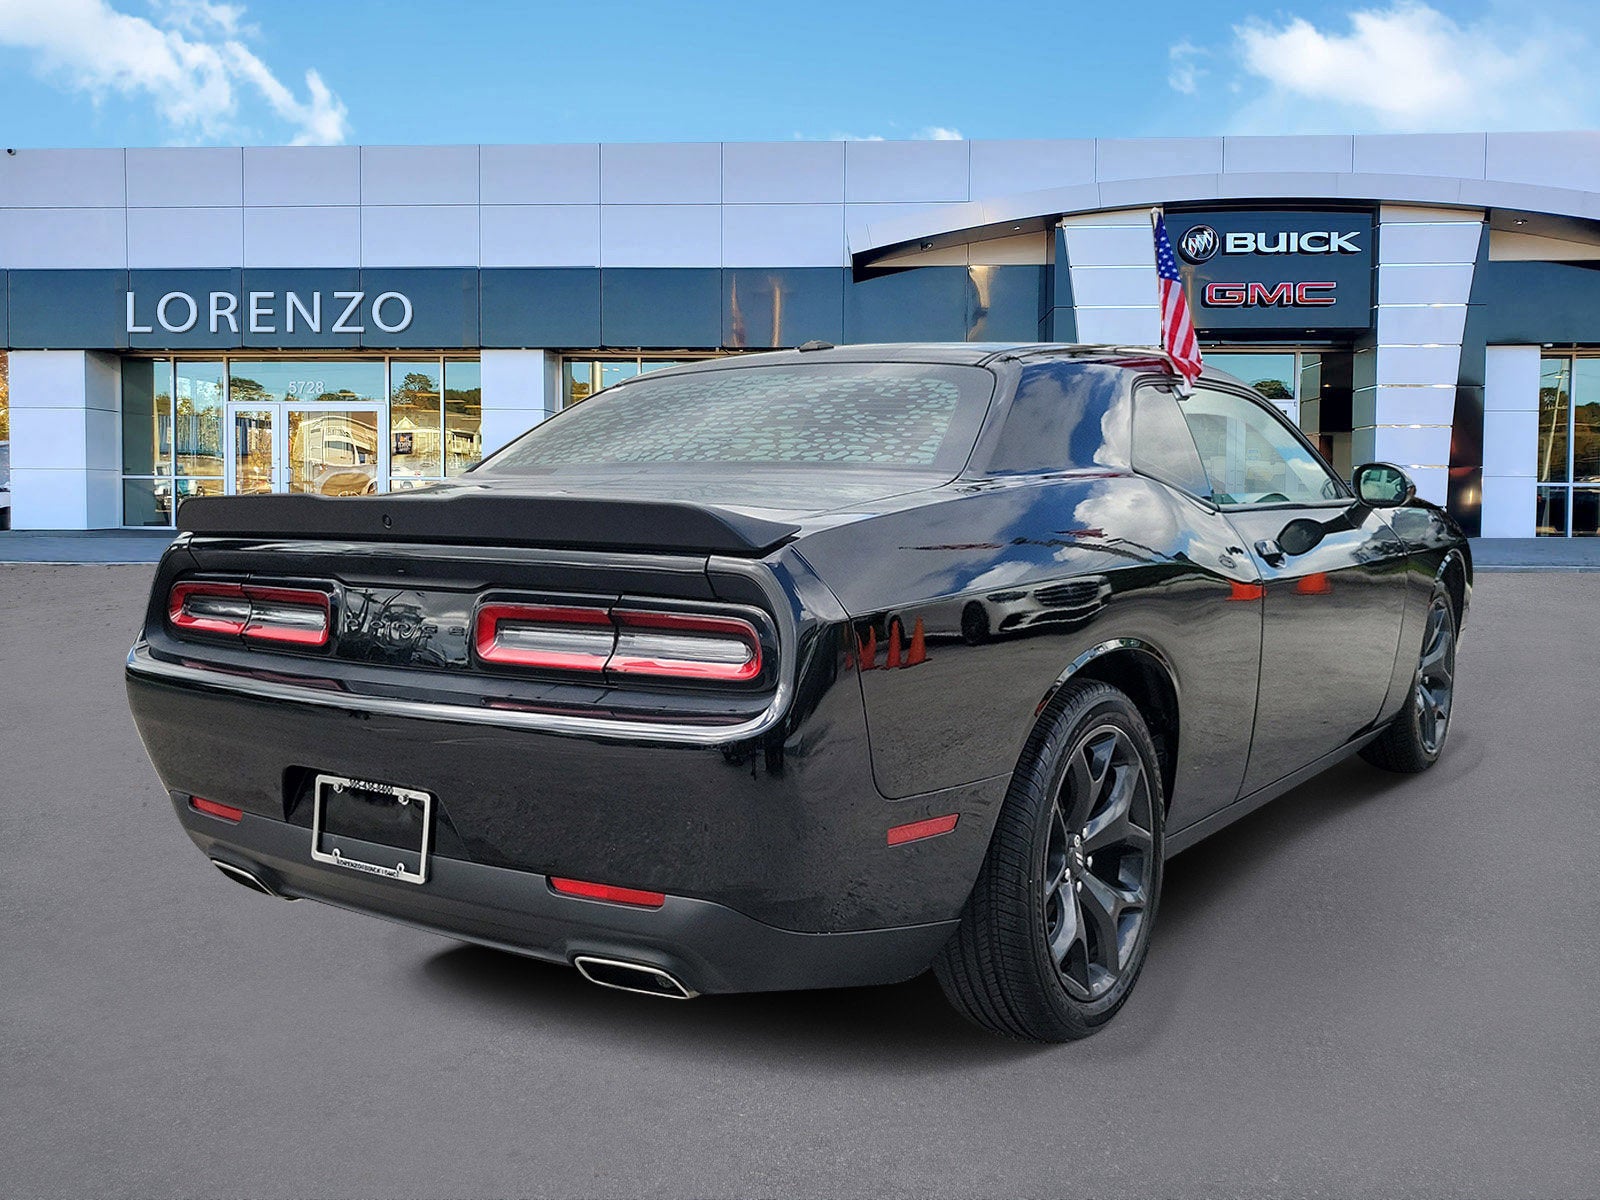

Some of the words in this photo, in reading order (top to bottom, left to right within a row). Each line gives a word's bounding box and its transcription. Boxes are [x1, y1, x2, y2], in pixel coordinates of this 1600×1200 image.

[1225, 231, 1362, 254] BUICK
[1204, 281, 1337, 306] GMC
[125, 290, 414, 334] LORENZO
[288, 380, 325, 394] 5728
